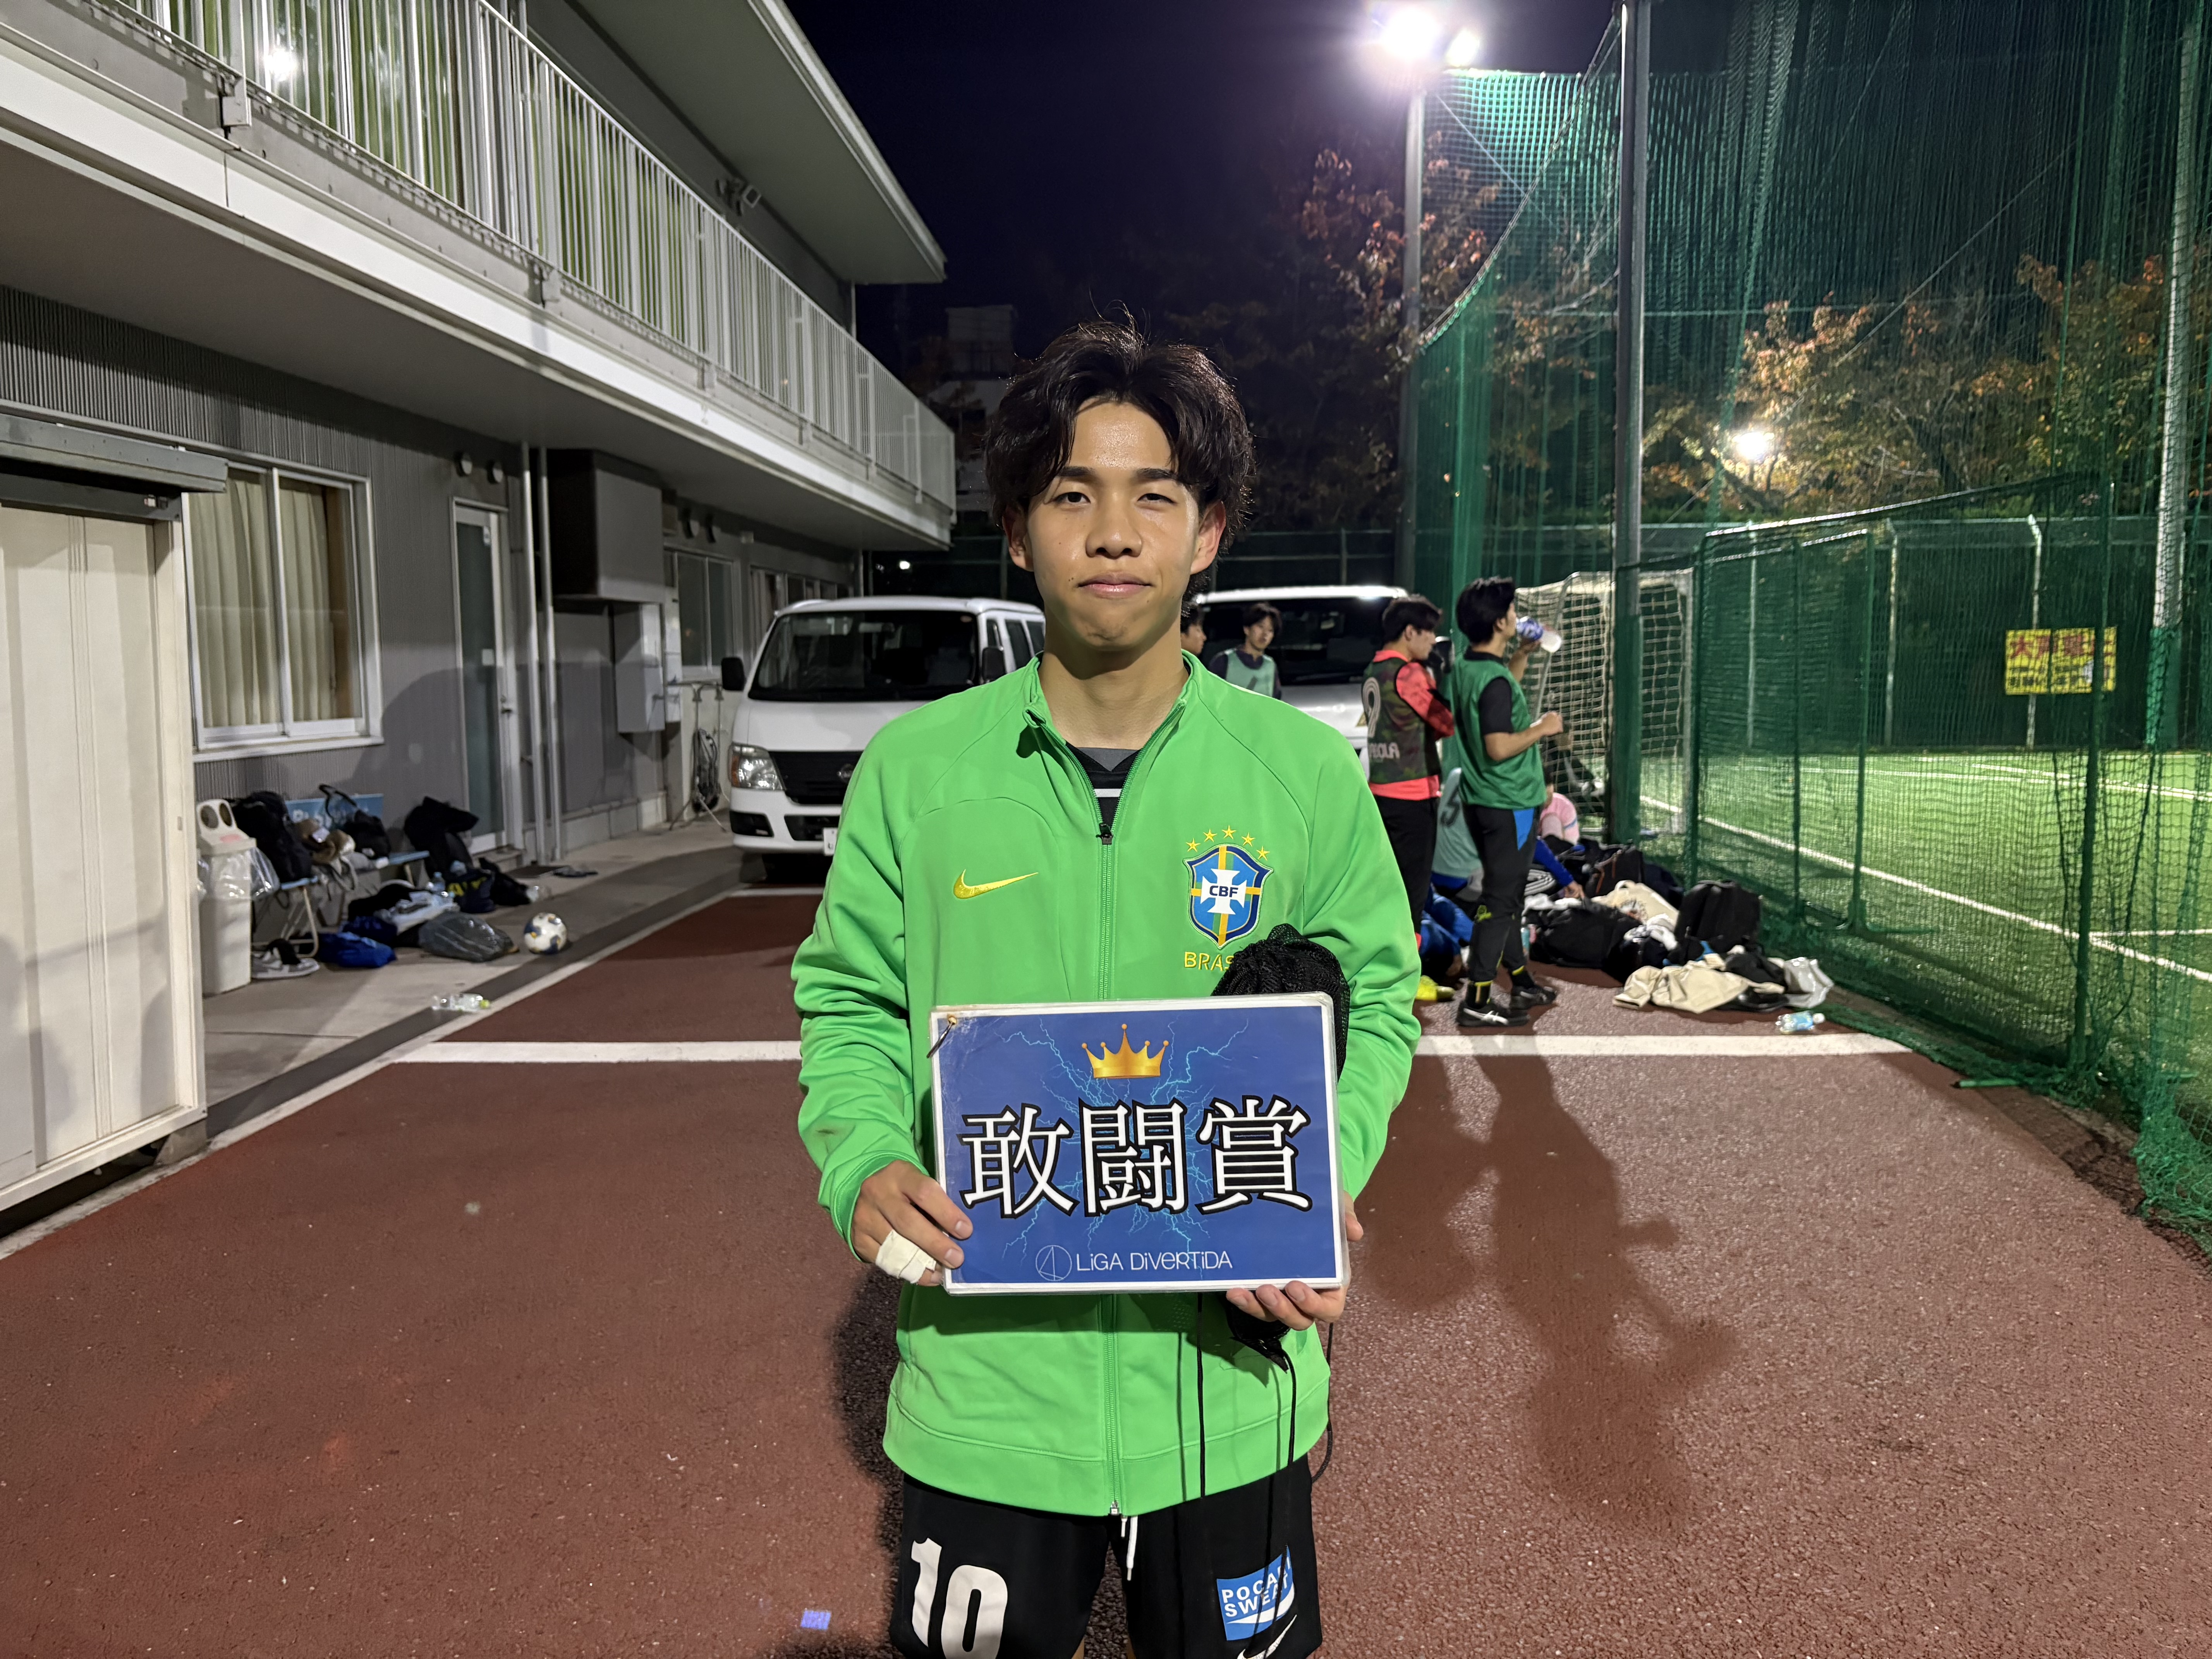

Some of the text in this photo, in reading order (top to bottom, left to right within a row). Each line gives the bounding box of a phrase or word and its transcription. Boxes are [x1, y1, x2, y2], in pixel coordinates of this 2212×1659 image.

[1362, 677, 1381, 738] 9
[1209, 885, 1238, 898] CBF
[1185, 951, 1234, 972] BRAS
[957, 1095, 1313, 1218] 敢闘賞
[911, 1537, 1008, 1659] 10
